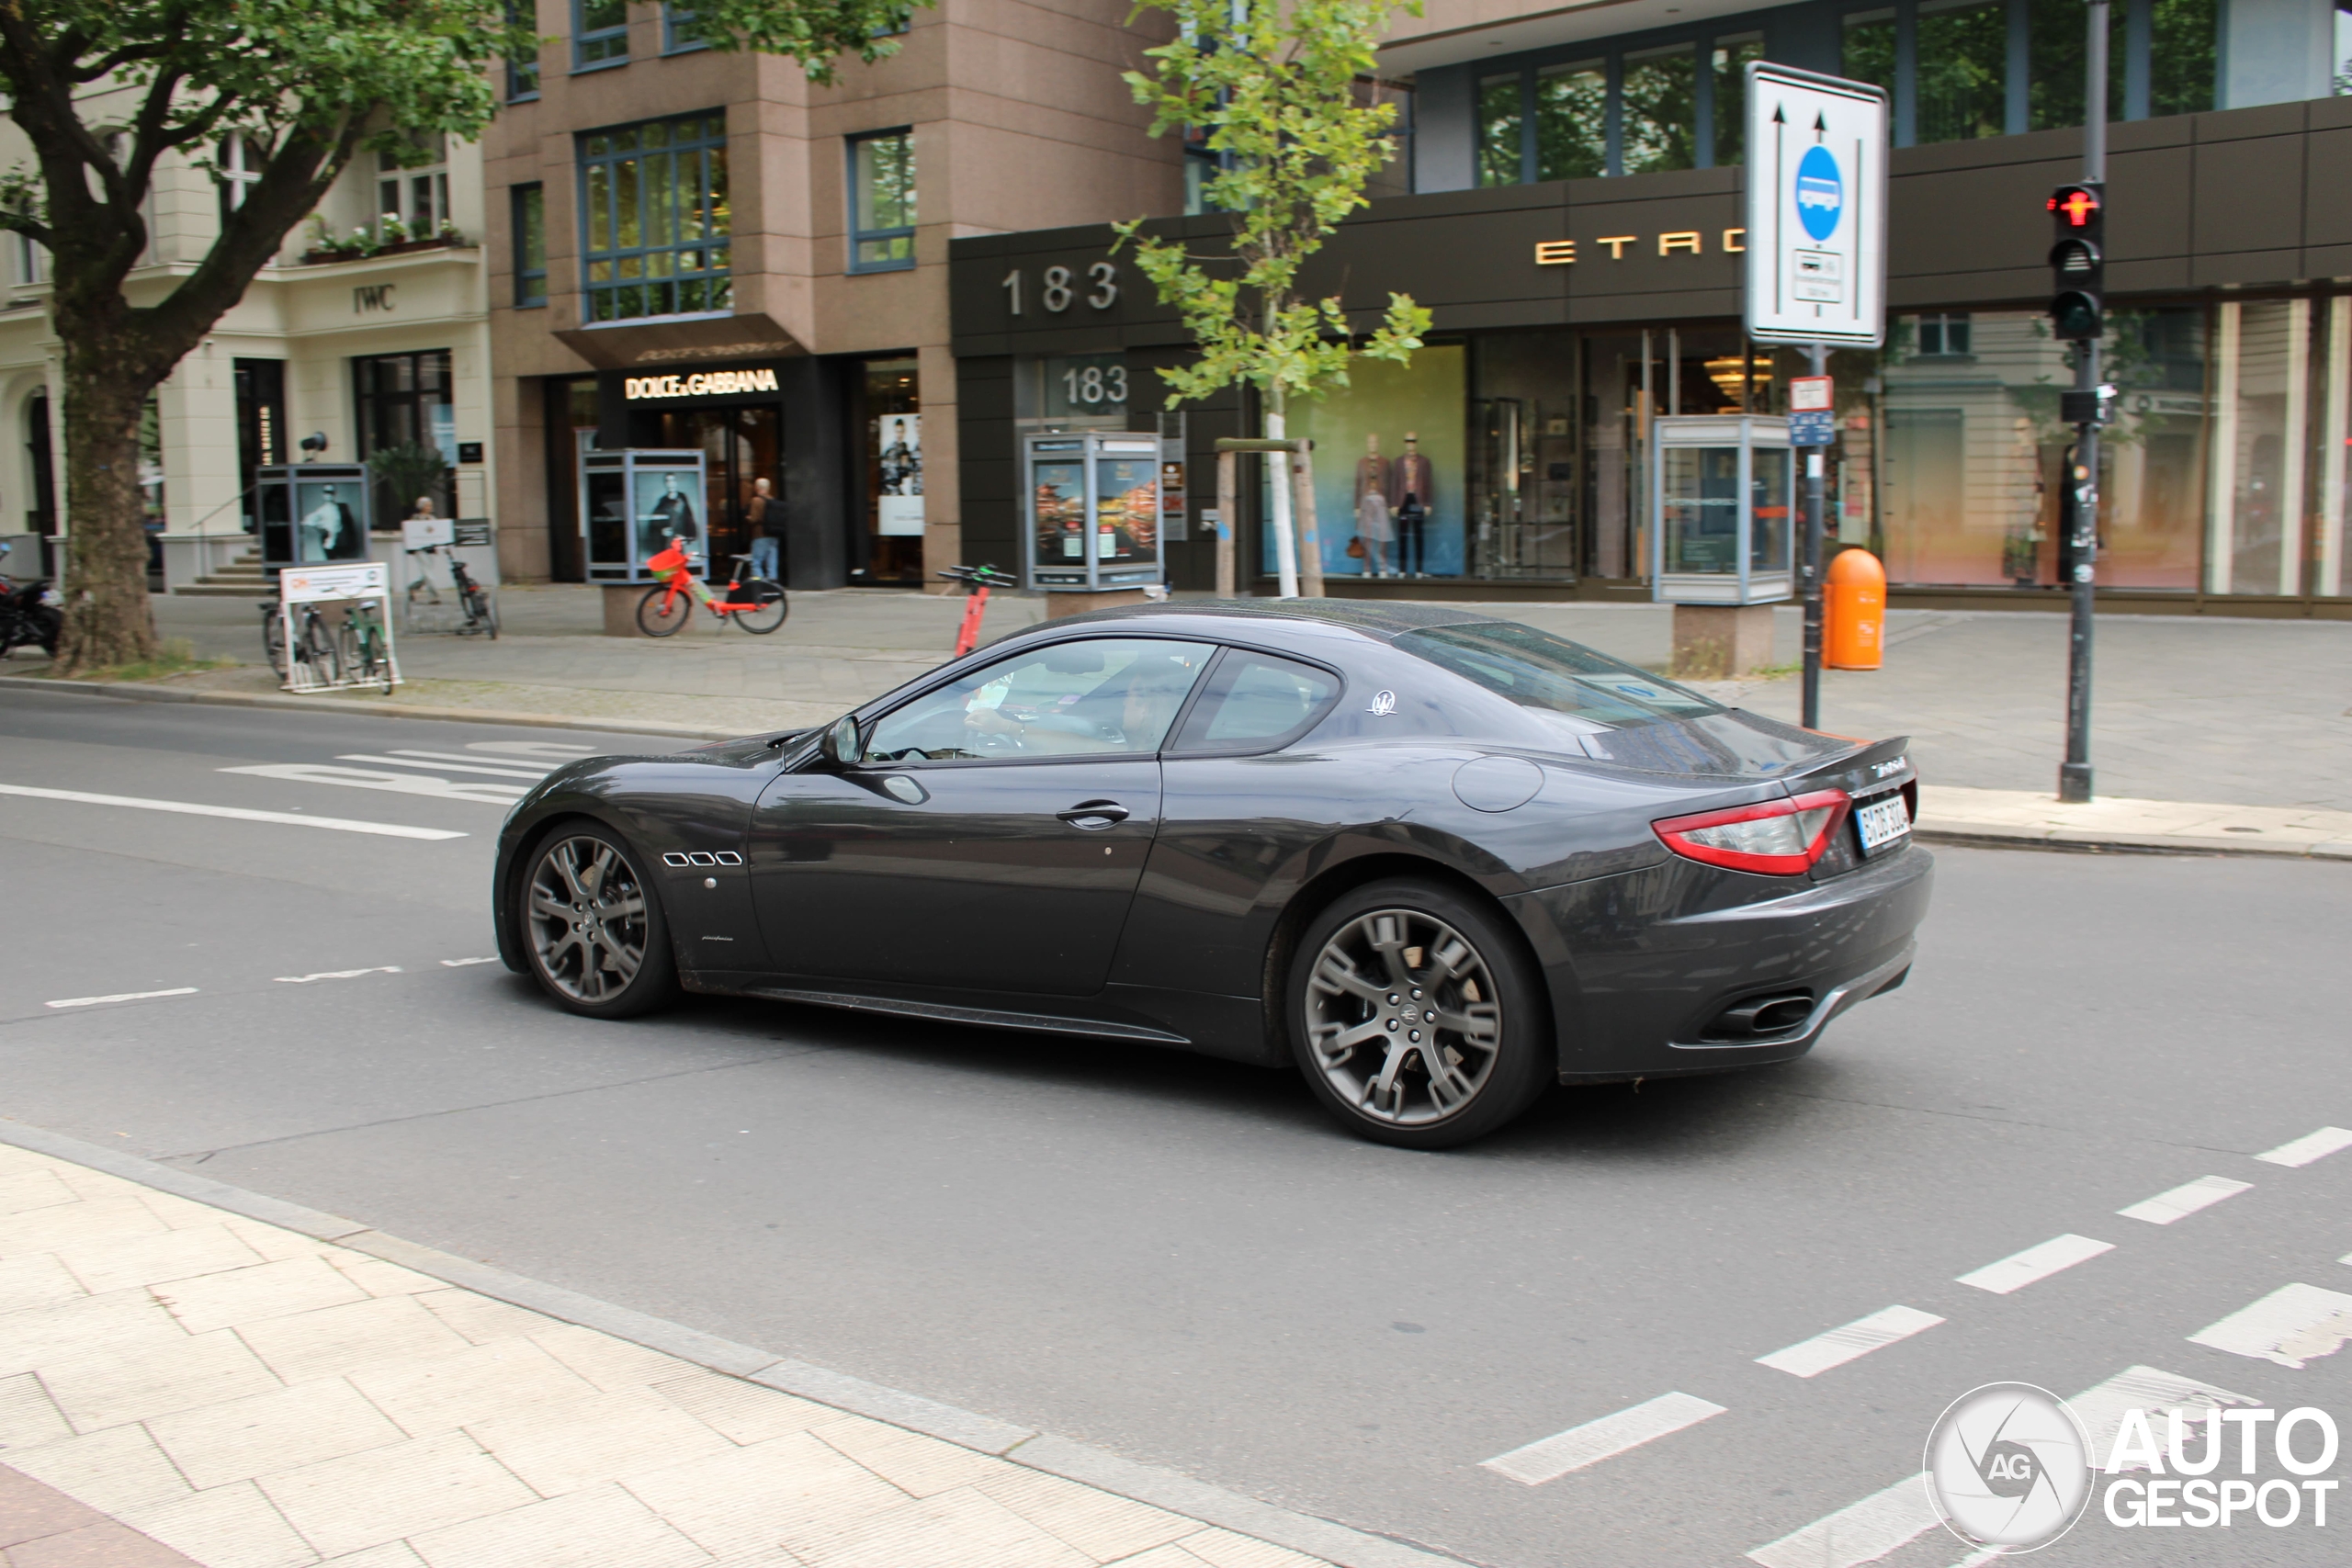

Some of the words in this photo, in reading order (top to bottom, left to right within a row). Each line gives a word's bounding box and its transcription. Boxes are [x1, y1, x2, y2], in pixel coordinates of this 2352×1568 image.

[353, 283, 396, 315] IWC
[1001, 262, 1118, 316] 183
[1062, 365, 1128, 405] 183
